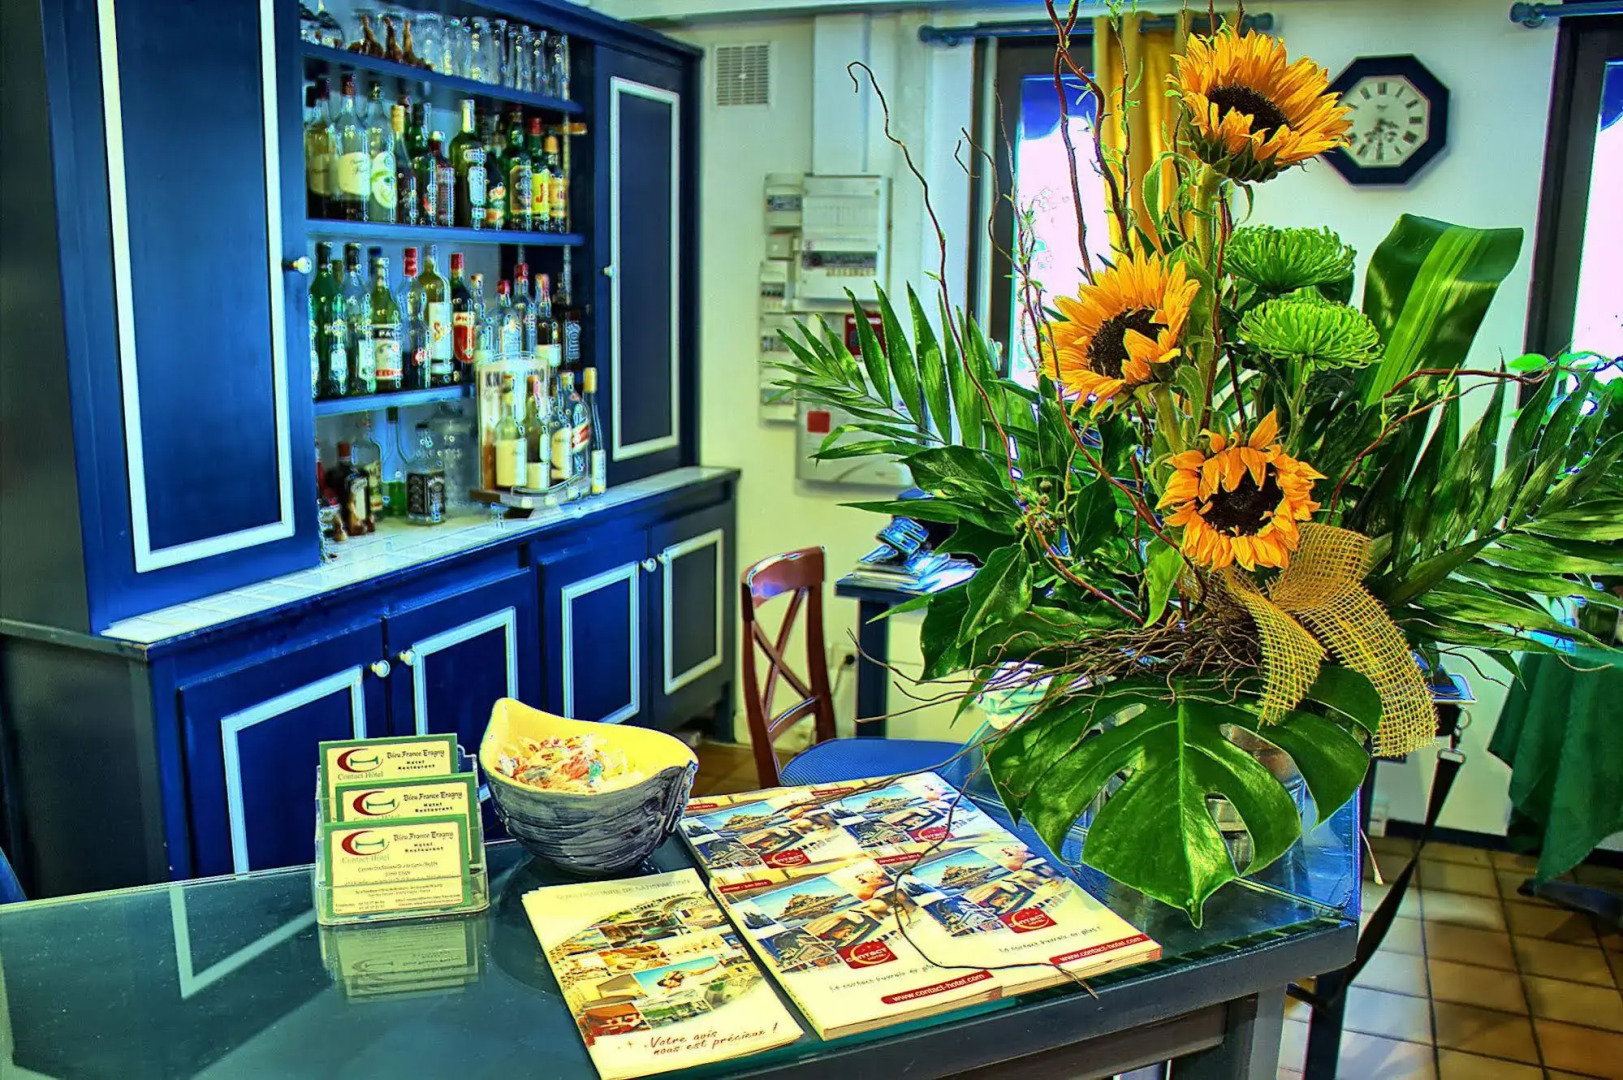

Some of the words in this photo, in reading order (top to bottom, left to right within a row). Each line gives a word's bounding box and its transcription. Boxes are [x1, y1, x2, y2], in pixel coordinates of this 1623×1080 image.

[401, 750, 421, 758] France
[422, 749, 445, 758] Eragny
[338, 773, 364, 781] Contact
[419, 793, 439, 801] France
[440, 791, 462, 800] Eragny
[409, 832, 430, 840] France
[430, 831, 453, 840] Eragny
[1059, 936, 1144, 962] www.contact-hotel.com
[891, 973, 985, 1002] www.contact-hotel.com
[650, 1036, 687, 1048] Votre
[693, 1030, 718, 1041] avis
[653, 1045, 680, 1056] nous
[686, 1039, 706, 1050] est
[711, 1030, 766, 1050] précieux
